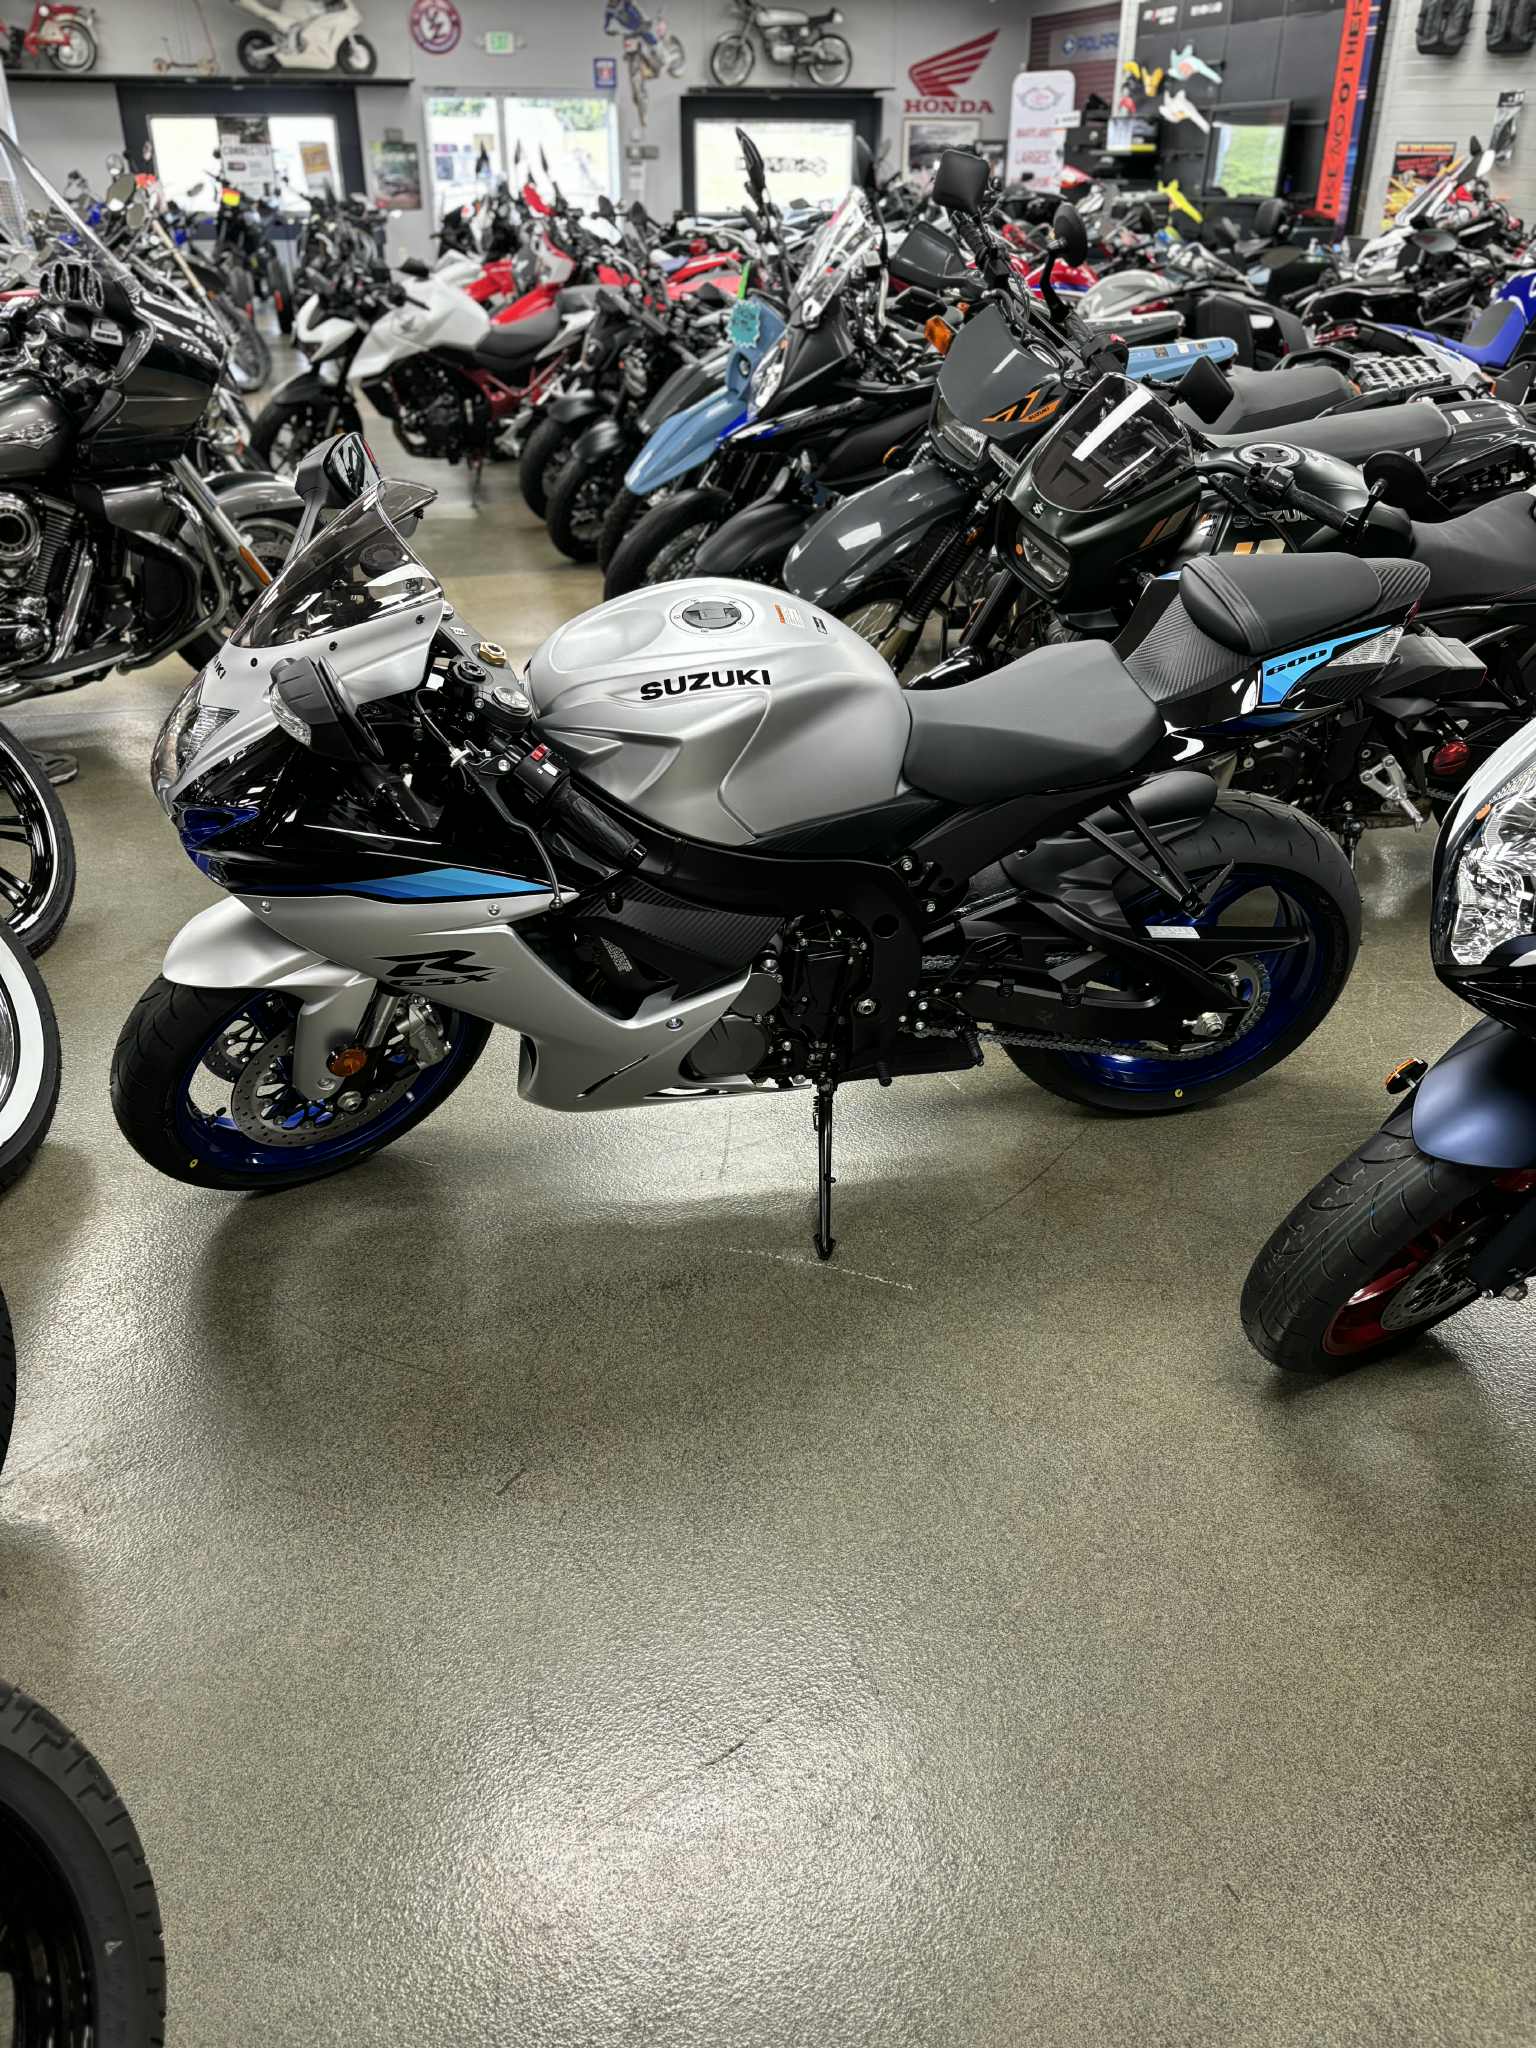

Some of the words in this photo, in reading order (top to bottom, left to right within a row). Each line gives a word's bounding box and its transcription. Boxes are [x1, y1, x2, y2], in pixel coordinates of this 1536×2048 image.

[905, 99, 994, 114] HONDA
[1265, 649, 1328, 676] 600
[640, 669, 771, 701] SUZUKI
[389, 971, 497, 986] GSX
